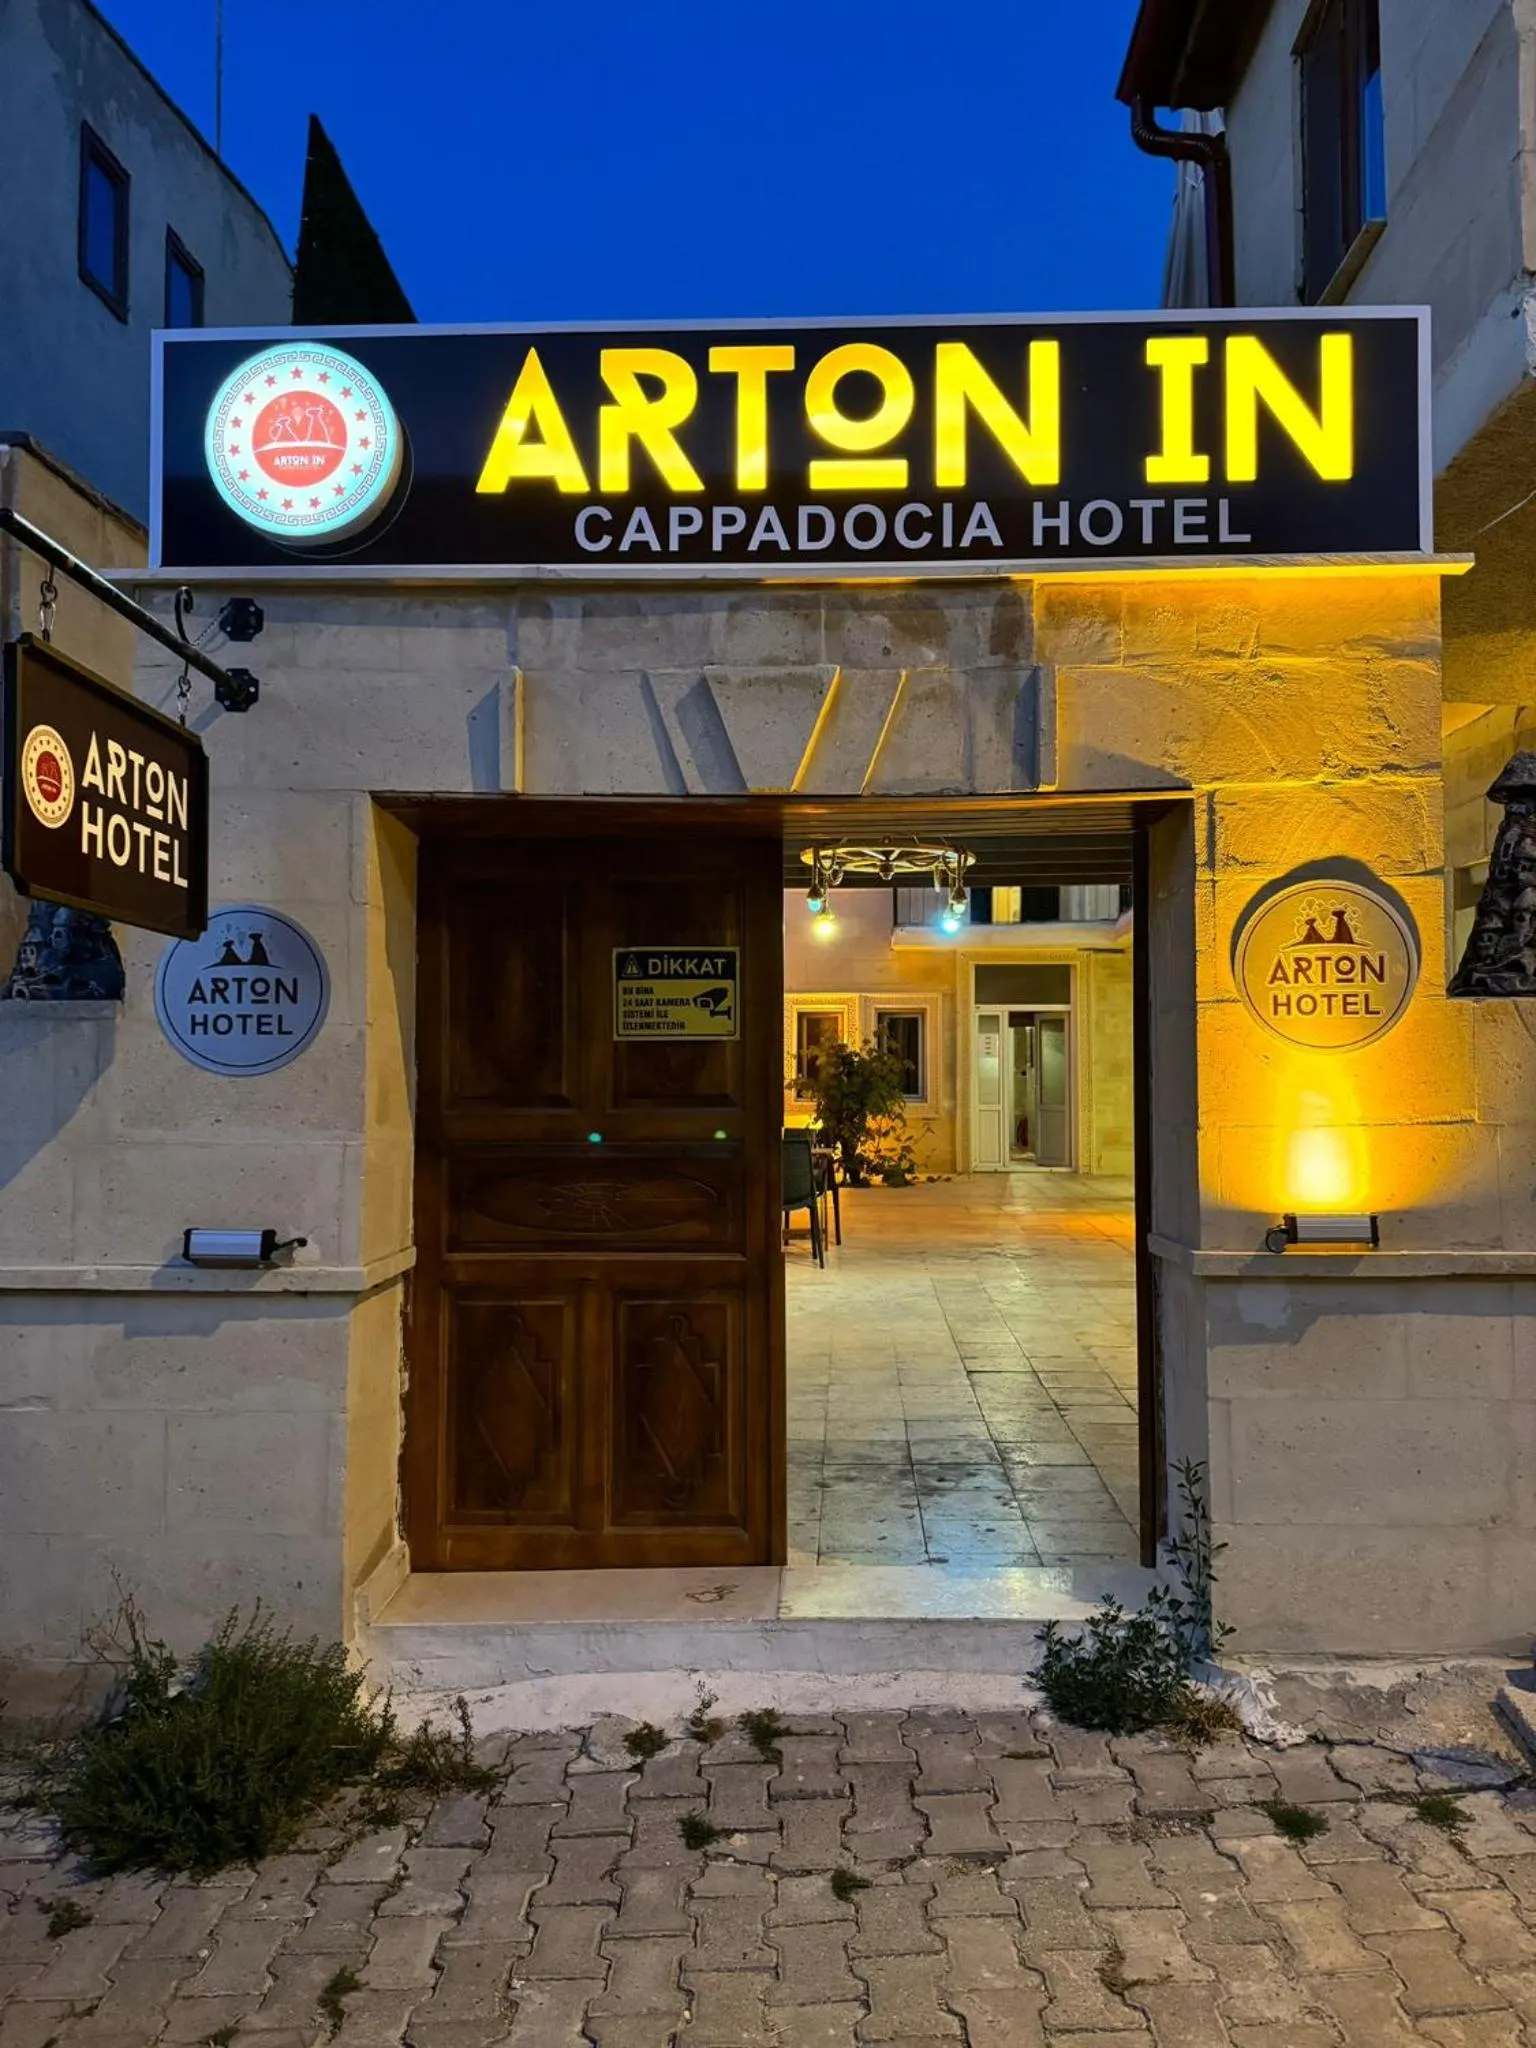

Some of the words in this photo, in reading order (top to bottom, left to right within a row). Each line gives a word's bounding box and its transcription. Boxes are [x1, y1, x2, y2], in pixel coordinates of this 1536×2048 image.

[474, 341, 1060, 493] ARTON
[1146, 333, 1354, 483] IN
[273, 455, 309, 466] ARTON
[574, 501, 1004, 553] CAPPADOCIA
[1031, 497, 1252, 547] HOTEL
[81, 730, 188, 831] ARTON
[81, 800, 188, 888] HOTEL
[647, 953, 727, 976] DİKKAT
[1267, 954, 1385, 985] ARTON
[186, 976, 299, 1005] ARTON
[1272, 993, 1381, 1016] HOTEL
[190, 1013, 293, 1036] HOTEL
